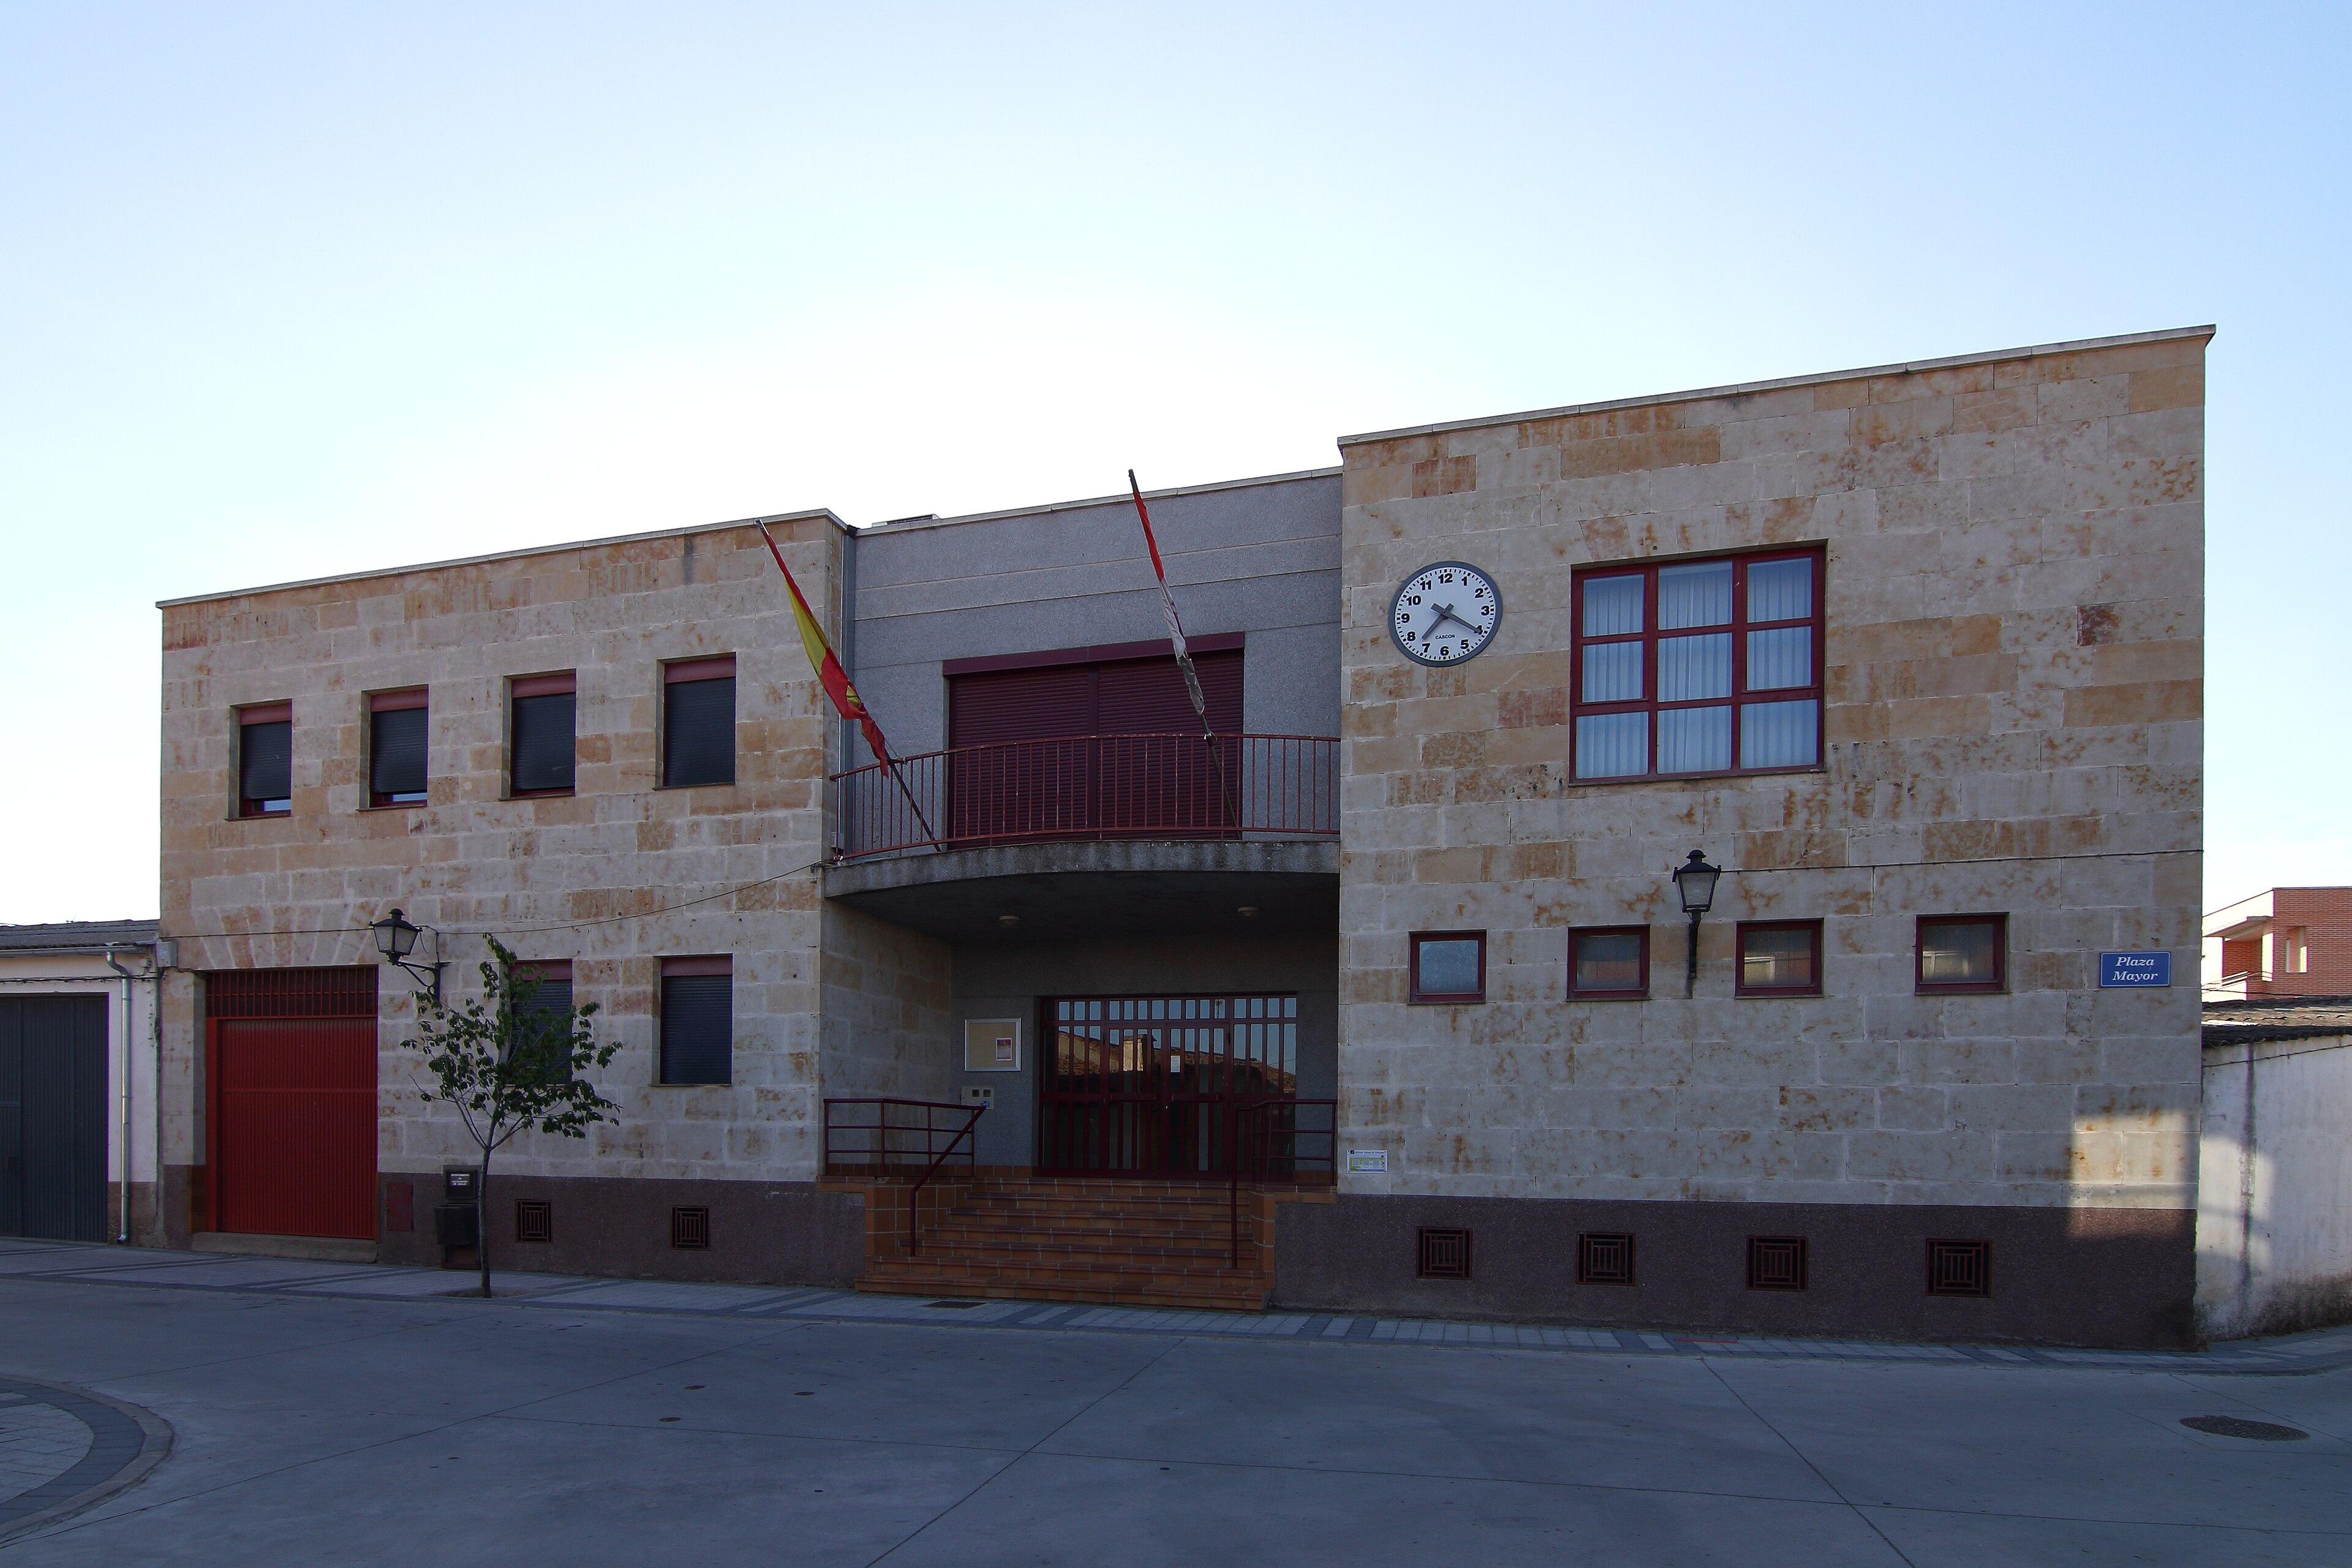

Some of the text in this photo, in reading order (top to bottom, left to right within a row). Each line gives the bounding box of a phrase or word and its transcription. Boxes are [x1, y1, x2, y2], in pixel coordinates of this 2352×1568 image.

[1438, 573, 1453, 584] 12
[1461, 576, 1468, 586] 1
[1420, 581, 1431, 590] 11
[1475, 588, 1483, 598] 2
[1406, 595, 1421, 606] 10
[1481, 606, 1490, 616] 3
[1401, 613, 1410, 623] 9
[1474, 625, 1483, 635] 4
[1407, 631, 1415, 641] 8
[1422, 643, 1430, 653] 7
[1460, 639, 1469, 649] 5
[1440, 646, 1449, 656] 6
[2116, 957, 2155, 967] Plaza
[2112, 971, 2158, 982] Mayor
